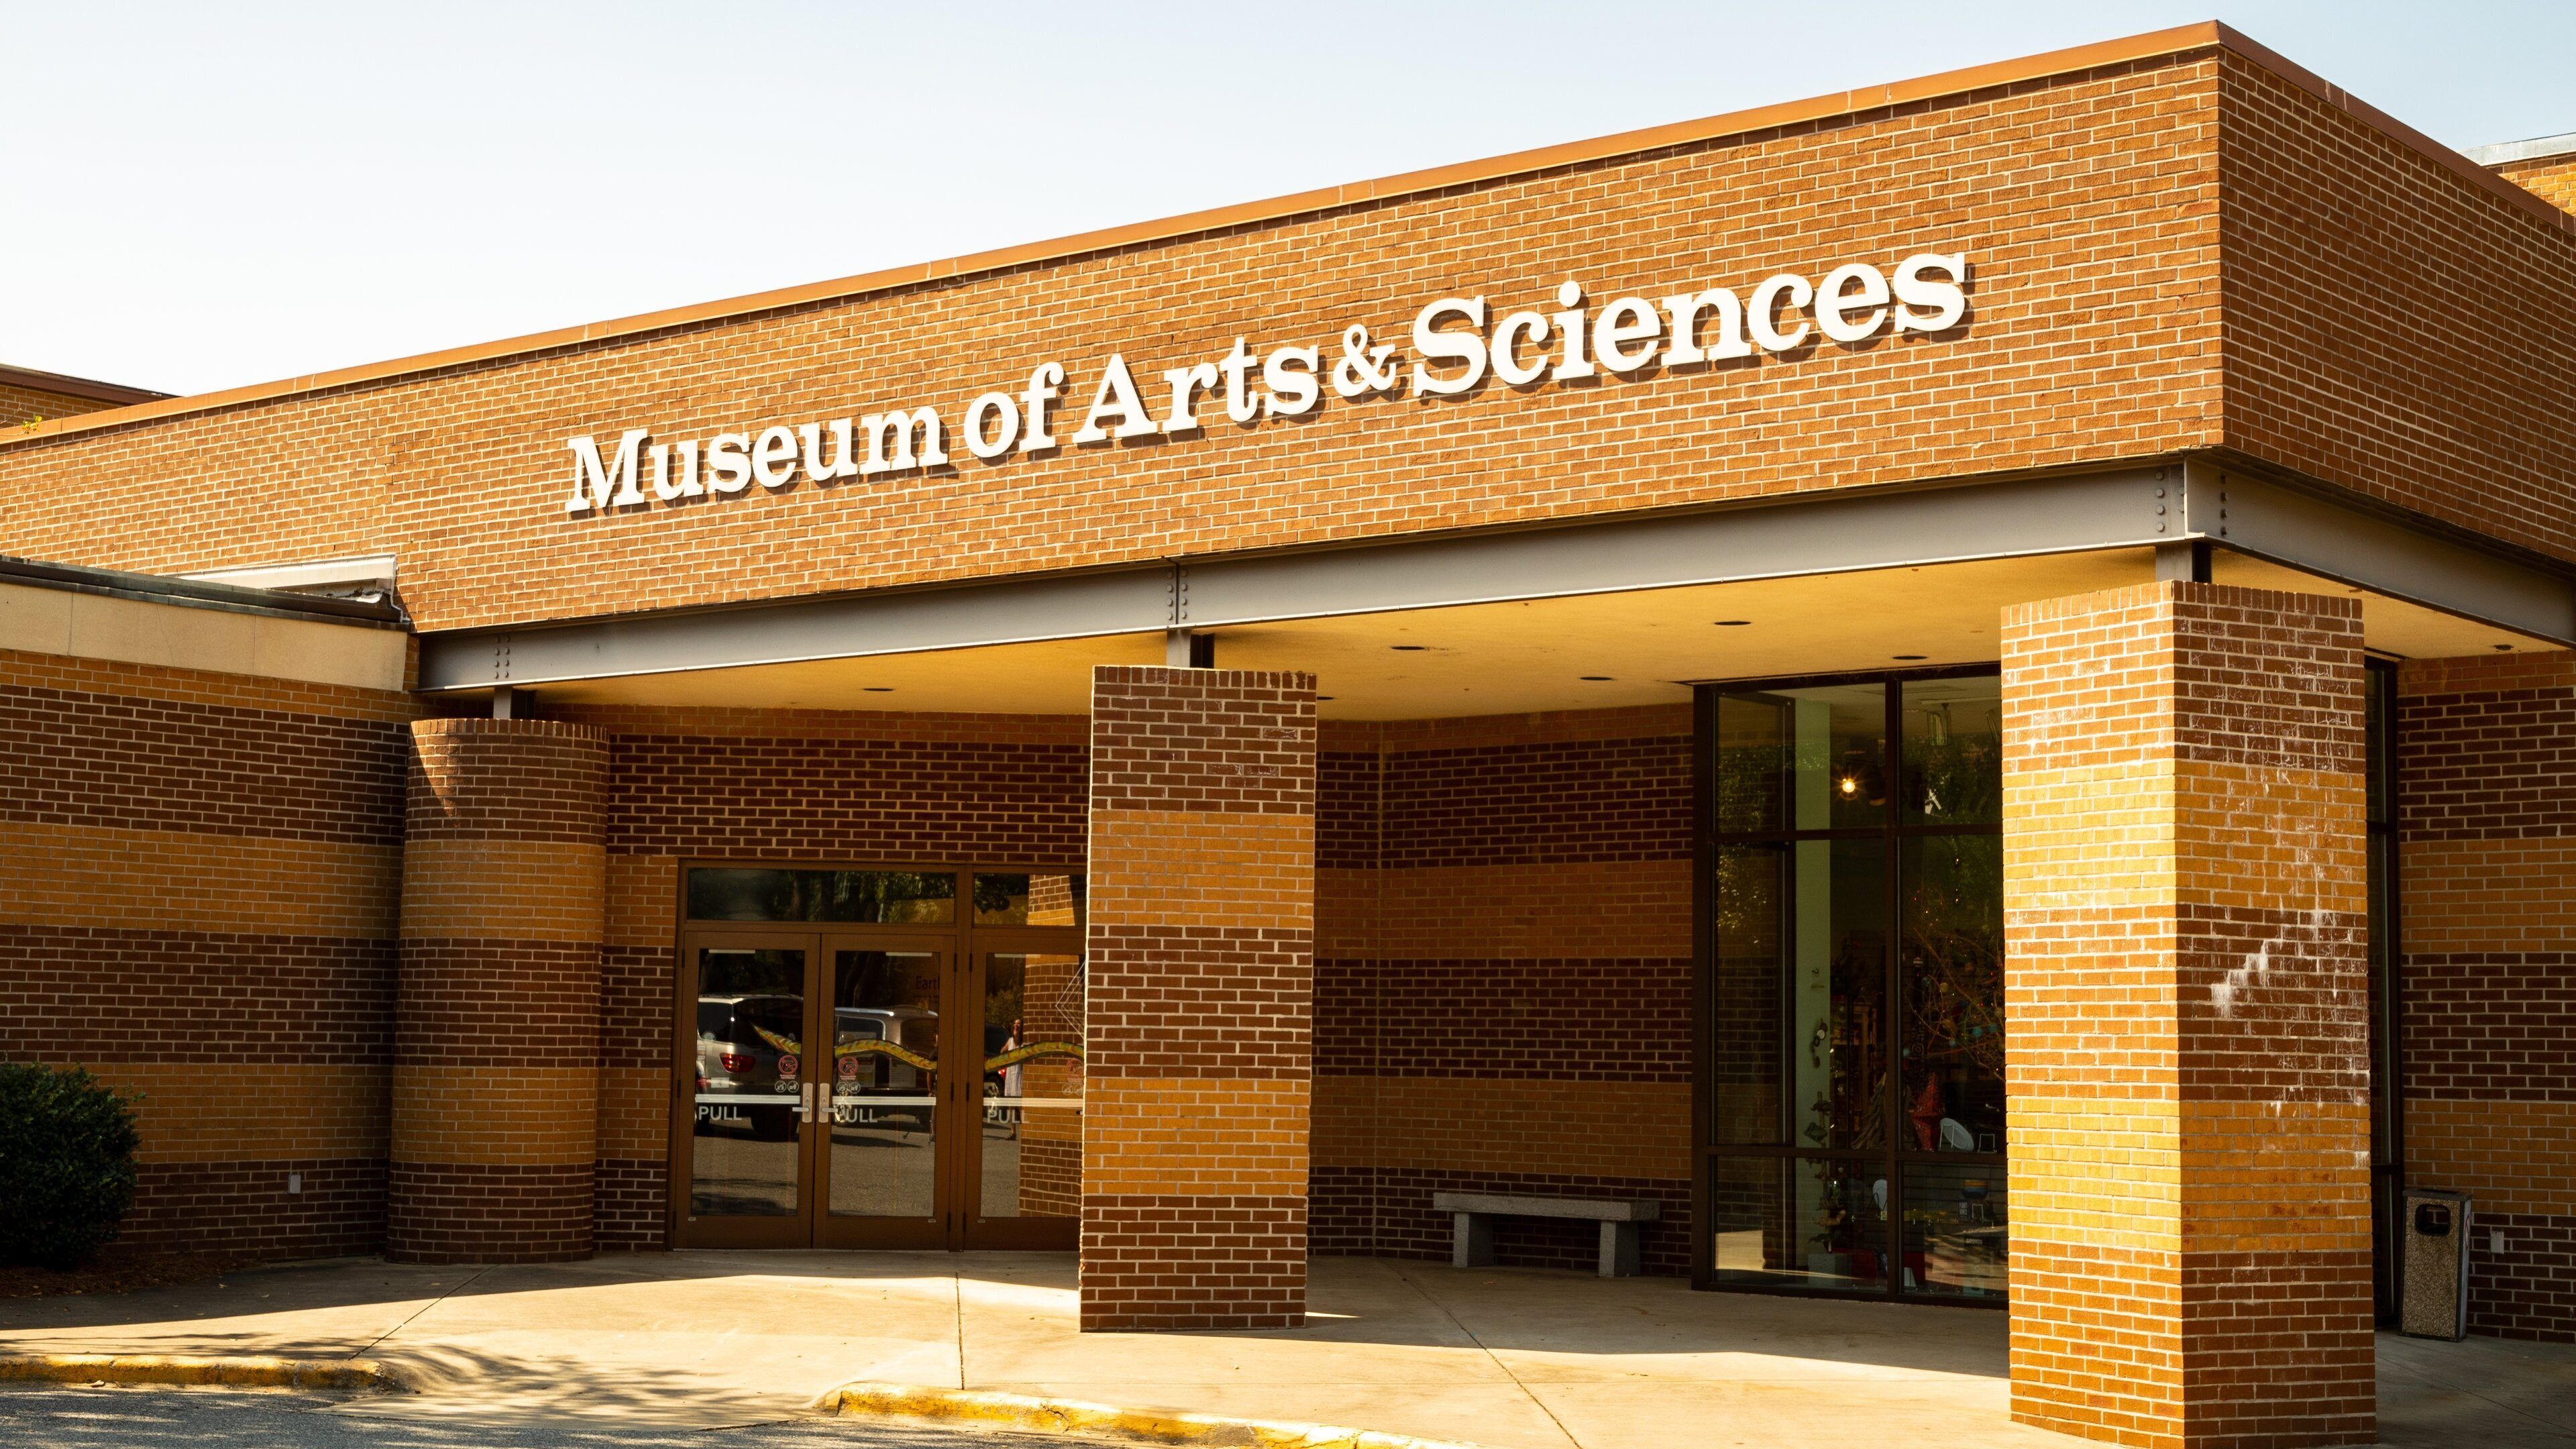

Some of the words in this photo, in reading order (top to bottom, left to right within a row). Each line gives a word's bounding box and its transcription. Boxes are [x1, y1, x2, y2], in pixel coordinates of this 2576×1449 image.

[564, 405, 949, 513] Museum
[963, 362, 1065, 458] of
[698, 1106, 743, 1121] PULL
[987, 1109, 1030, 1124] PULL
